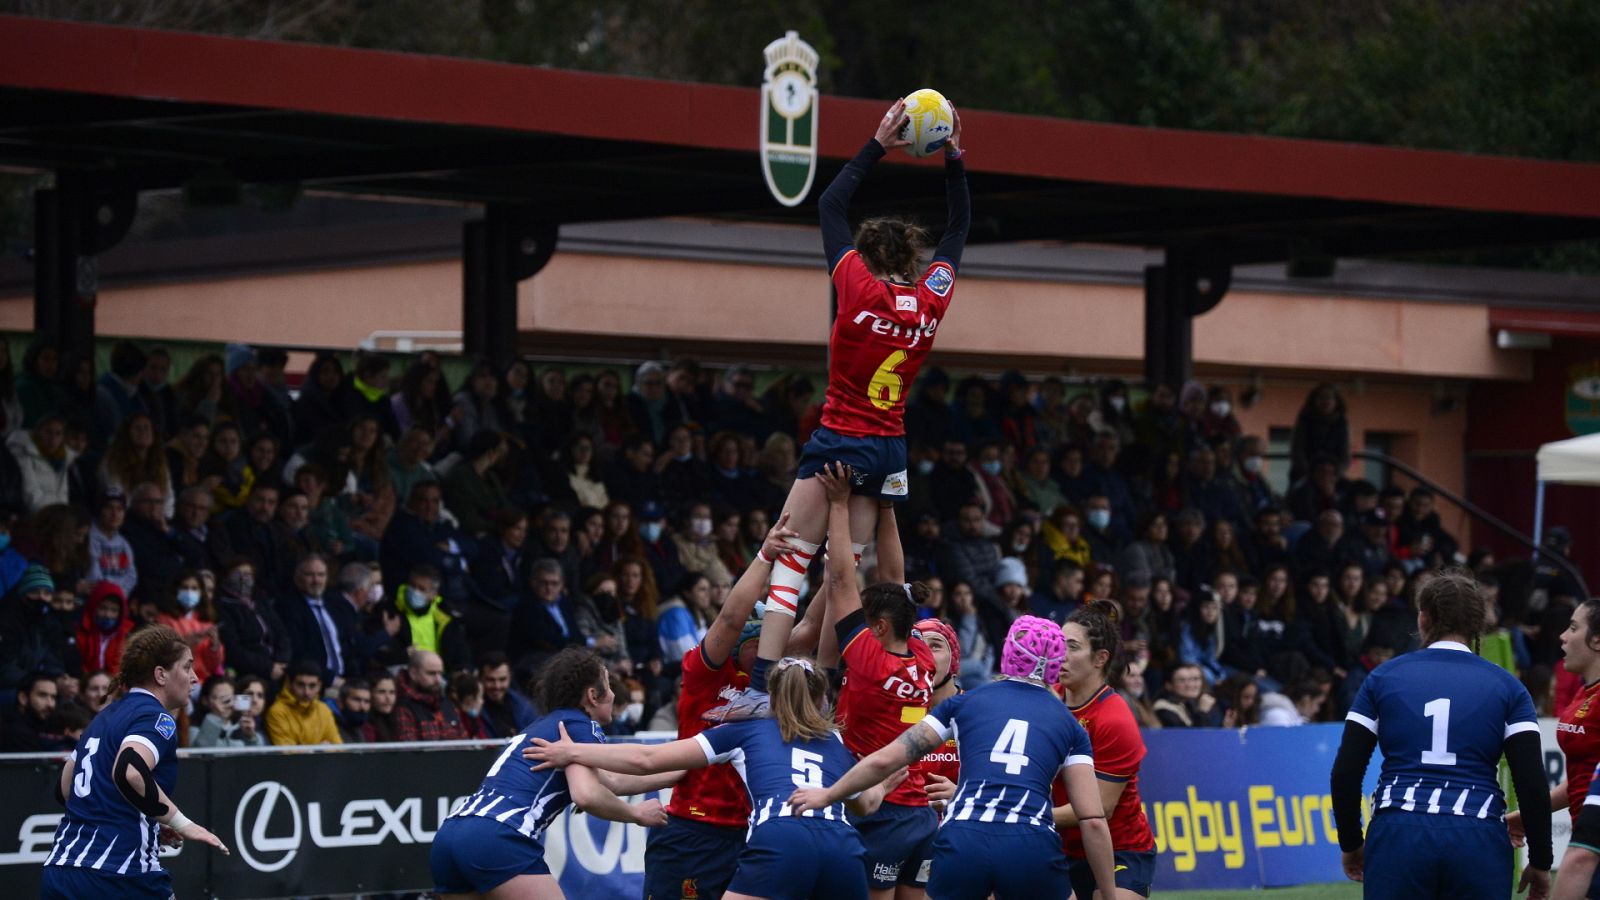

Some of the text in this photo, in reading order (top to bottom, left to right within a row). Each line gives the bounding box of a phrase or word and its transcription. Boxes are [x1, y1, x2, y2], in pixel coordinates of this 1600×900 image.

[853, 310, 938, 348] renfe
[867, 349, 908, 411] 6
[990, 718, 1030, 775] 4
[1421, 697, 1457, 766] 1
[73, 737, 101, 798] 3
[791, 747, 824, 788] 5
[1142, 785, 1245, 872] ugby
